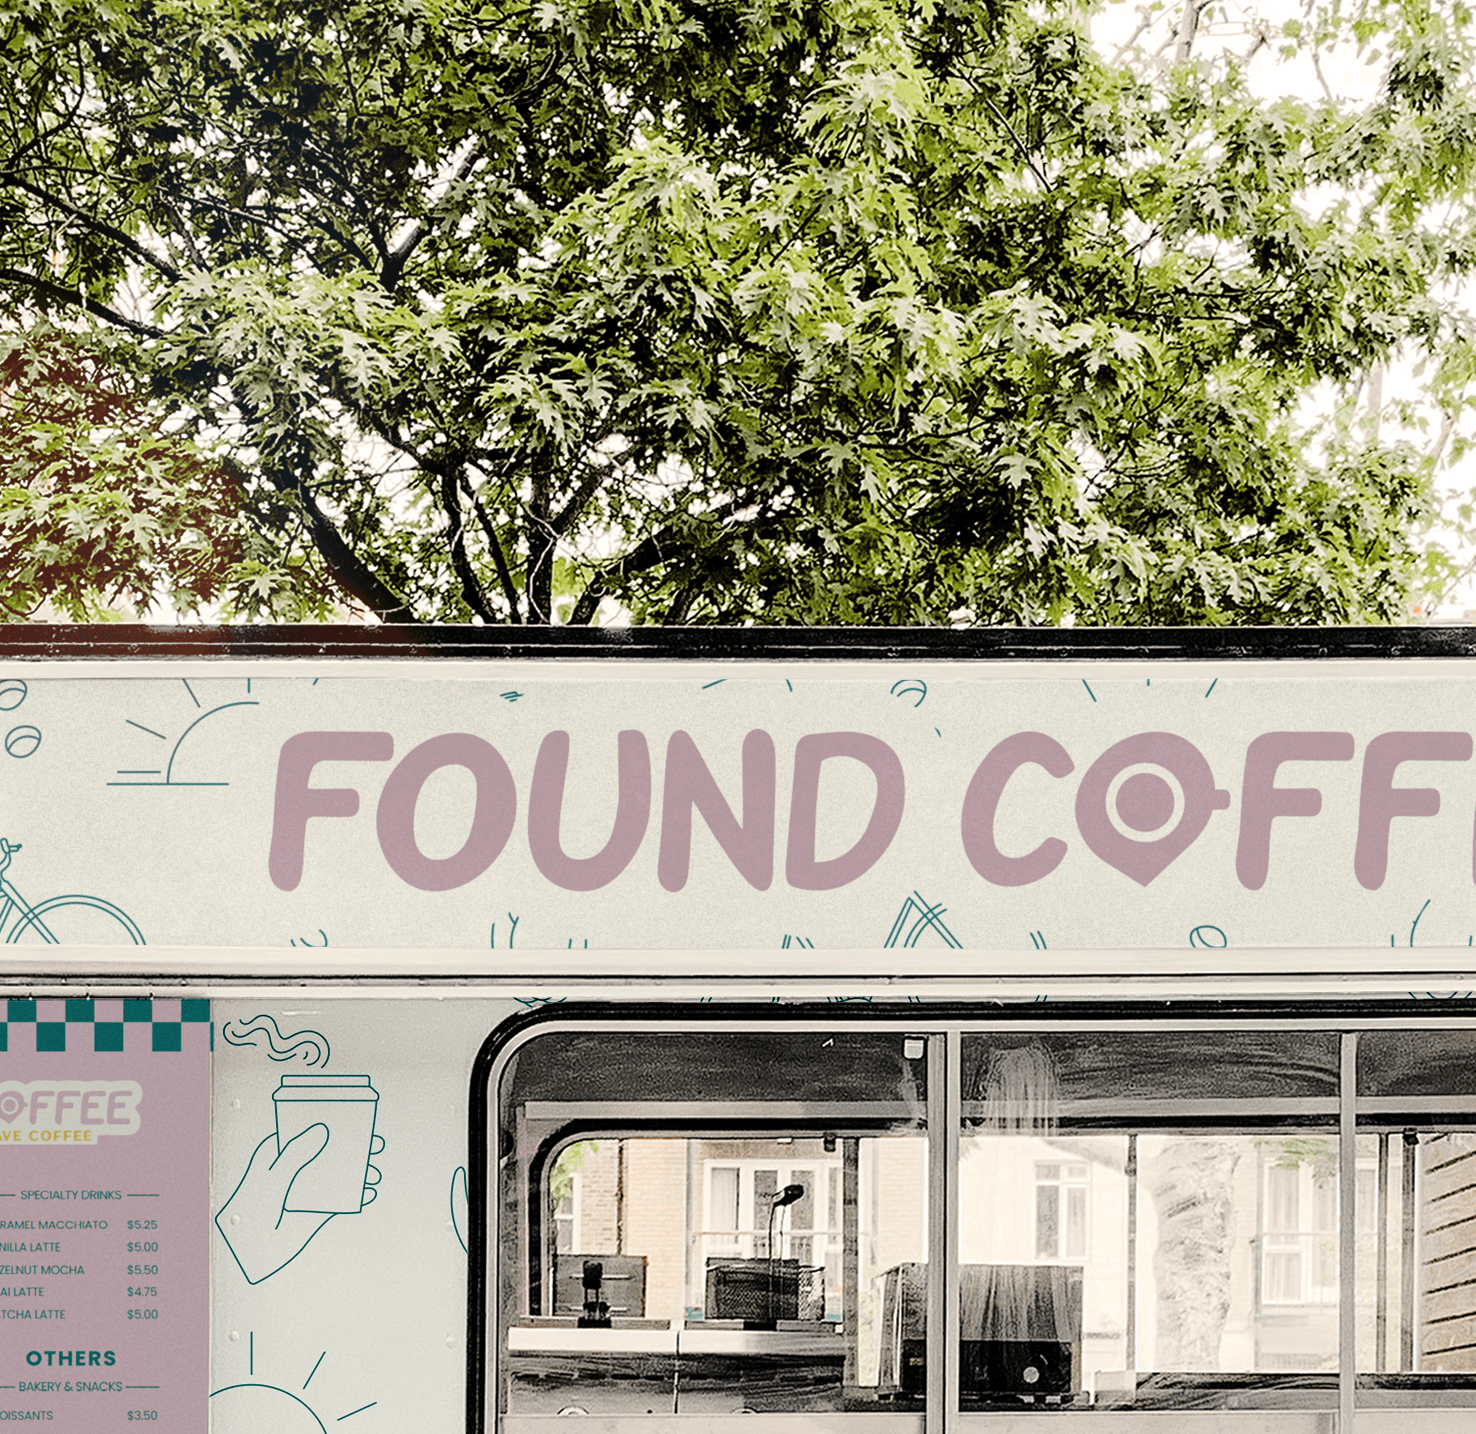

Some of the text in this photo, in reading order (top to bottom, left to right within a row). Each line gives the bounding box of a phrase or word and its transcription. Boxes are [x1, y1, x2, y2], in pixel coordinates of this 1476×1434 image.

[268, 728, 906, 893] FOUND
[28, 1130, 93, 1142] COFFEE
[20, 1189, 123, 1201] SPECIALTY DRINKS
[37, 1219, 109, 1231] MACCHIATO
[126, 1219, 158, 1231] $5.25
[29, 1241, 61, 1253] LATTE
[126, 1241, 159, 1253] $5.00
[40, 1264, 85, 1275] MOCHA
[126, 1264, 159, 1276] $5.50
[13, 1286, 44, 1297] LATTE
[126, 1286, 158, 1298] $4.75
[34, 1309, 66, 1320] LATTE
[126, 1308, 159, 1321] $5.00
[25, 1349, 117, 1367] OTHERS
[18, 1380, 123, 1393] BAKERY & SNACKS
[126, 1410, 159, 1422] $3.50
